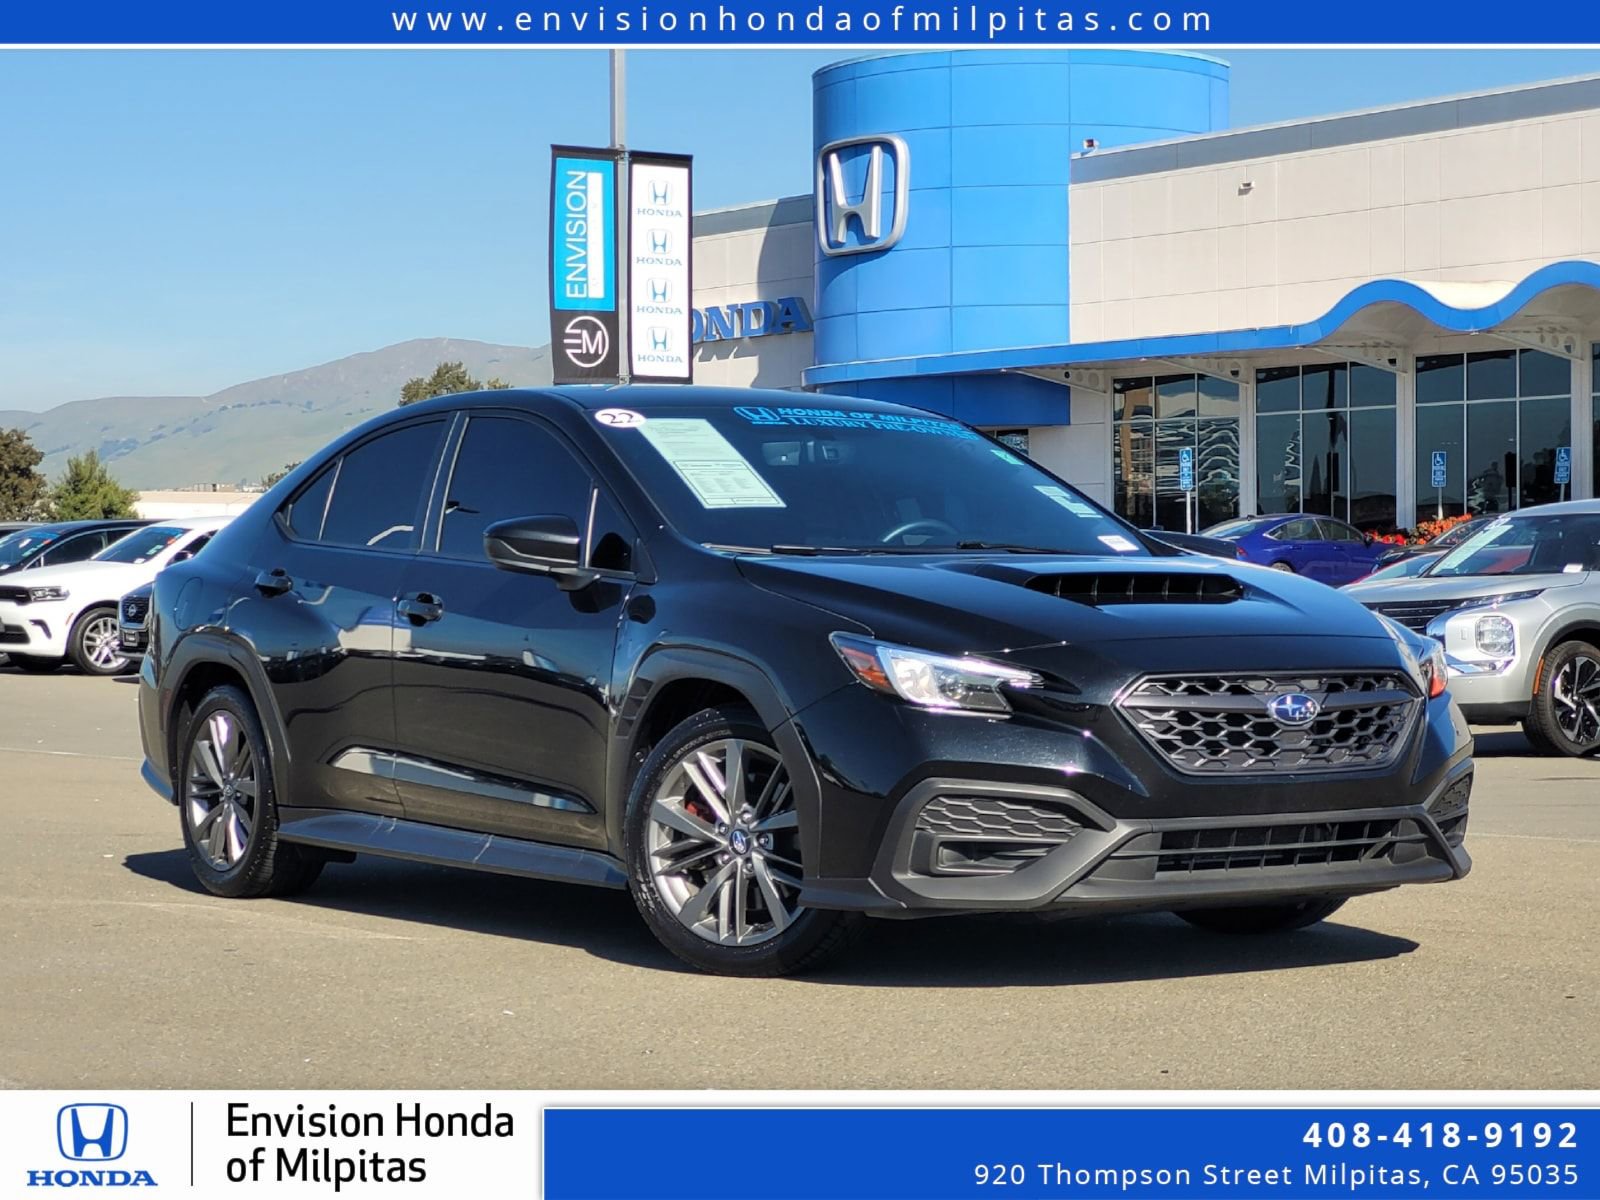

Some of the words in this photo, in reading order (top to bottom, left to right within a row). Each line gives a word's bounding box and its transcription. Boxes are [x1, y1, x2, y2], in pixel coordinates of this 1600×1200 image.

[637, 207, 683, 218] HONDA
[566, 170, 587, 299] ENVISION
[636, 256, 682, 266] HONDA
[636, 305, 683, 315] HONDA
[637, 354, 683, 364] HONDA
[601, 412, 642, 424] 22
[777, 407, 848, 418] HONDA
[849, 411, 874, 419] OF
